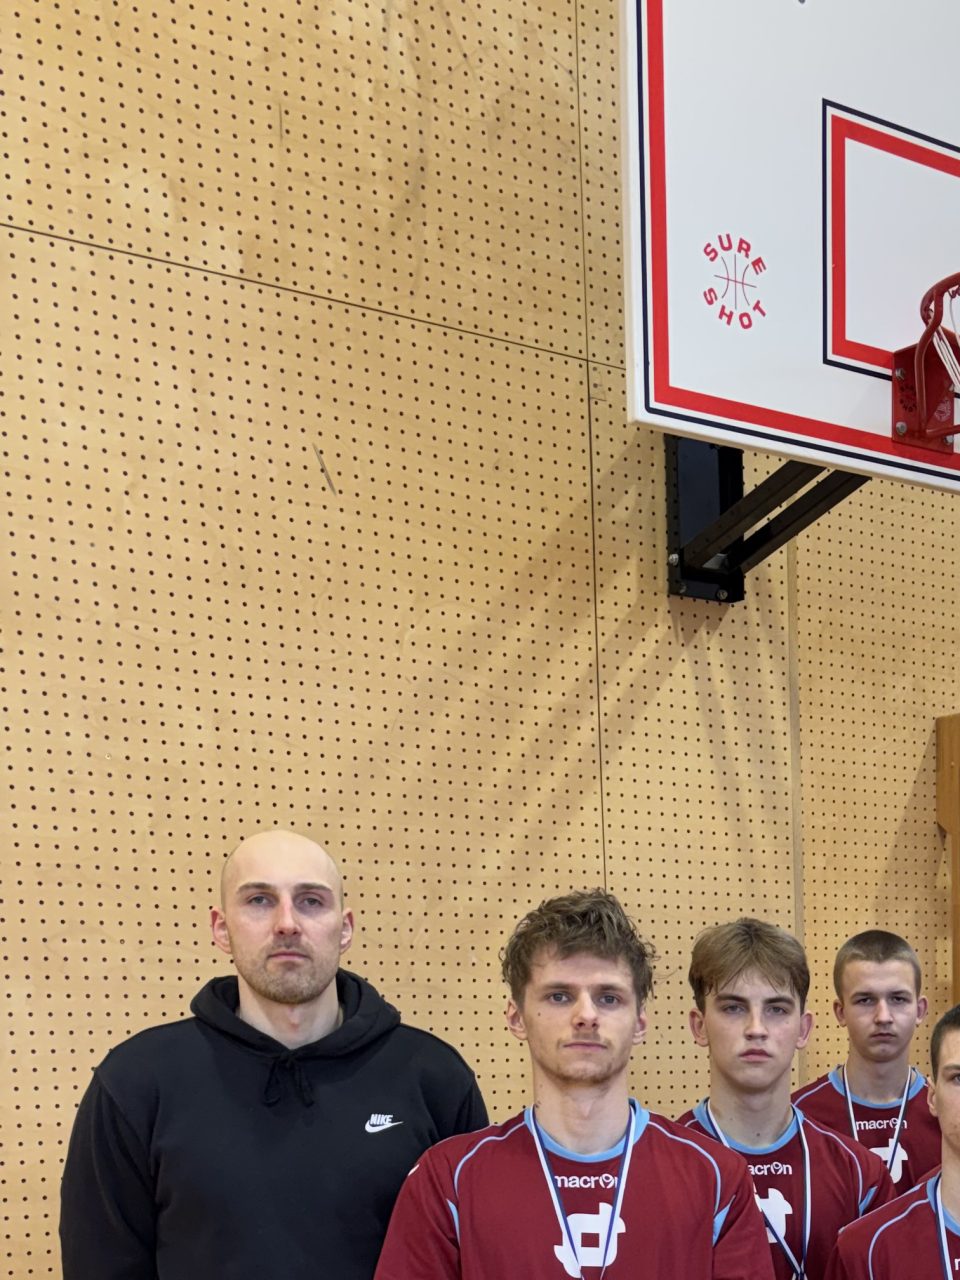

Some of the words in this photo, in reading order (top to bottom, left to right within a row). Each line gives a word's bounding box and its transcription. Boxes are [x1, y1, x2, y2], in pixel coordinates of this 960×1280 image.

[703, 233, 767, 275] SURE
[703, 287, 767, 330] SHOT
[370, 1113, 394, 1125] NIKE
[855, 1117, 908, 1131] macron
[747, 1161, 793, 1176] acron
